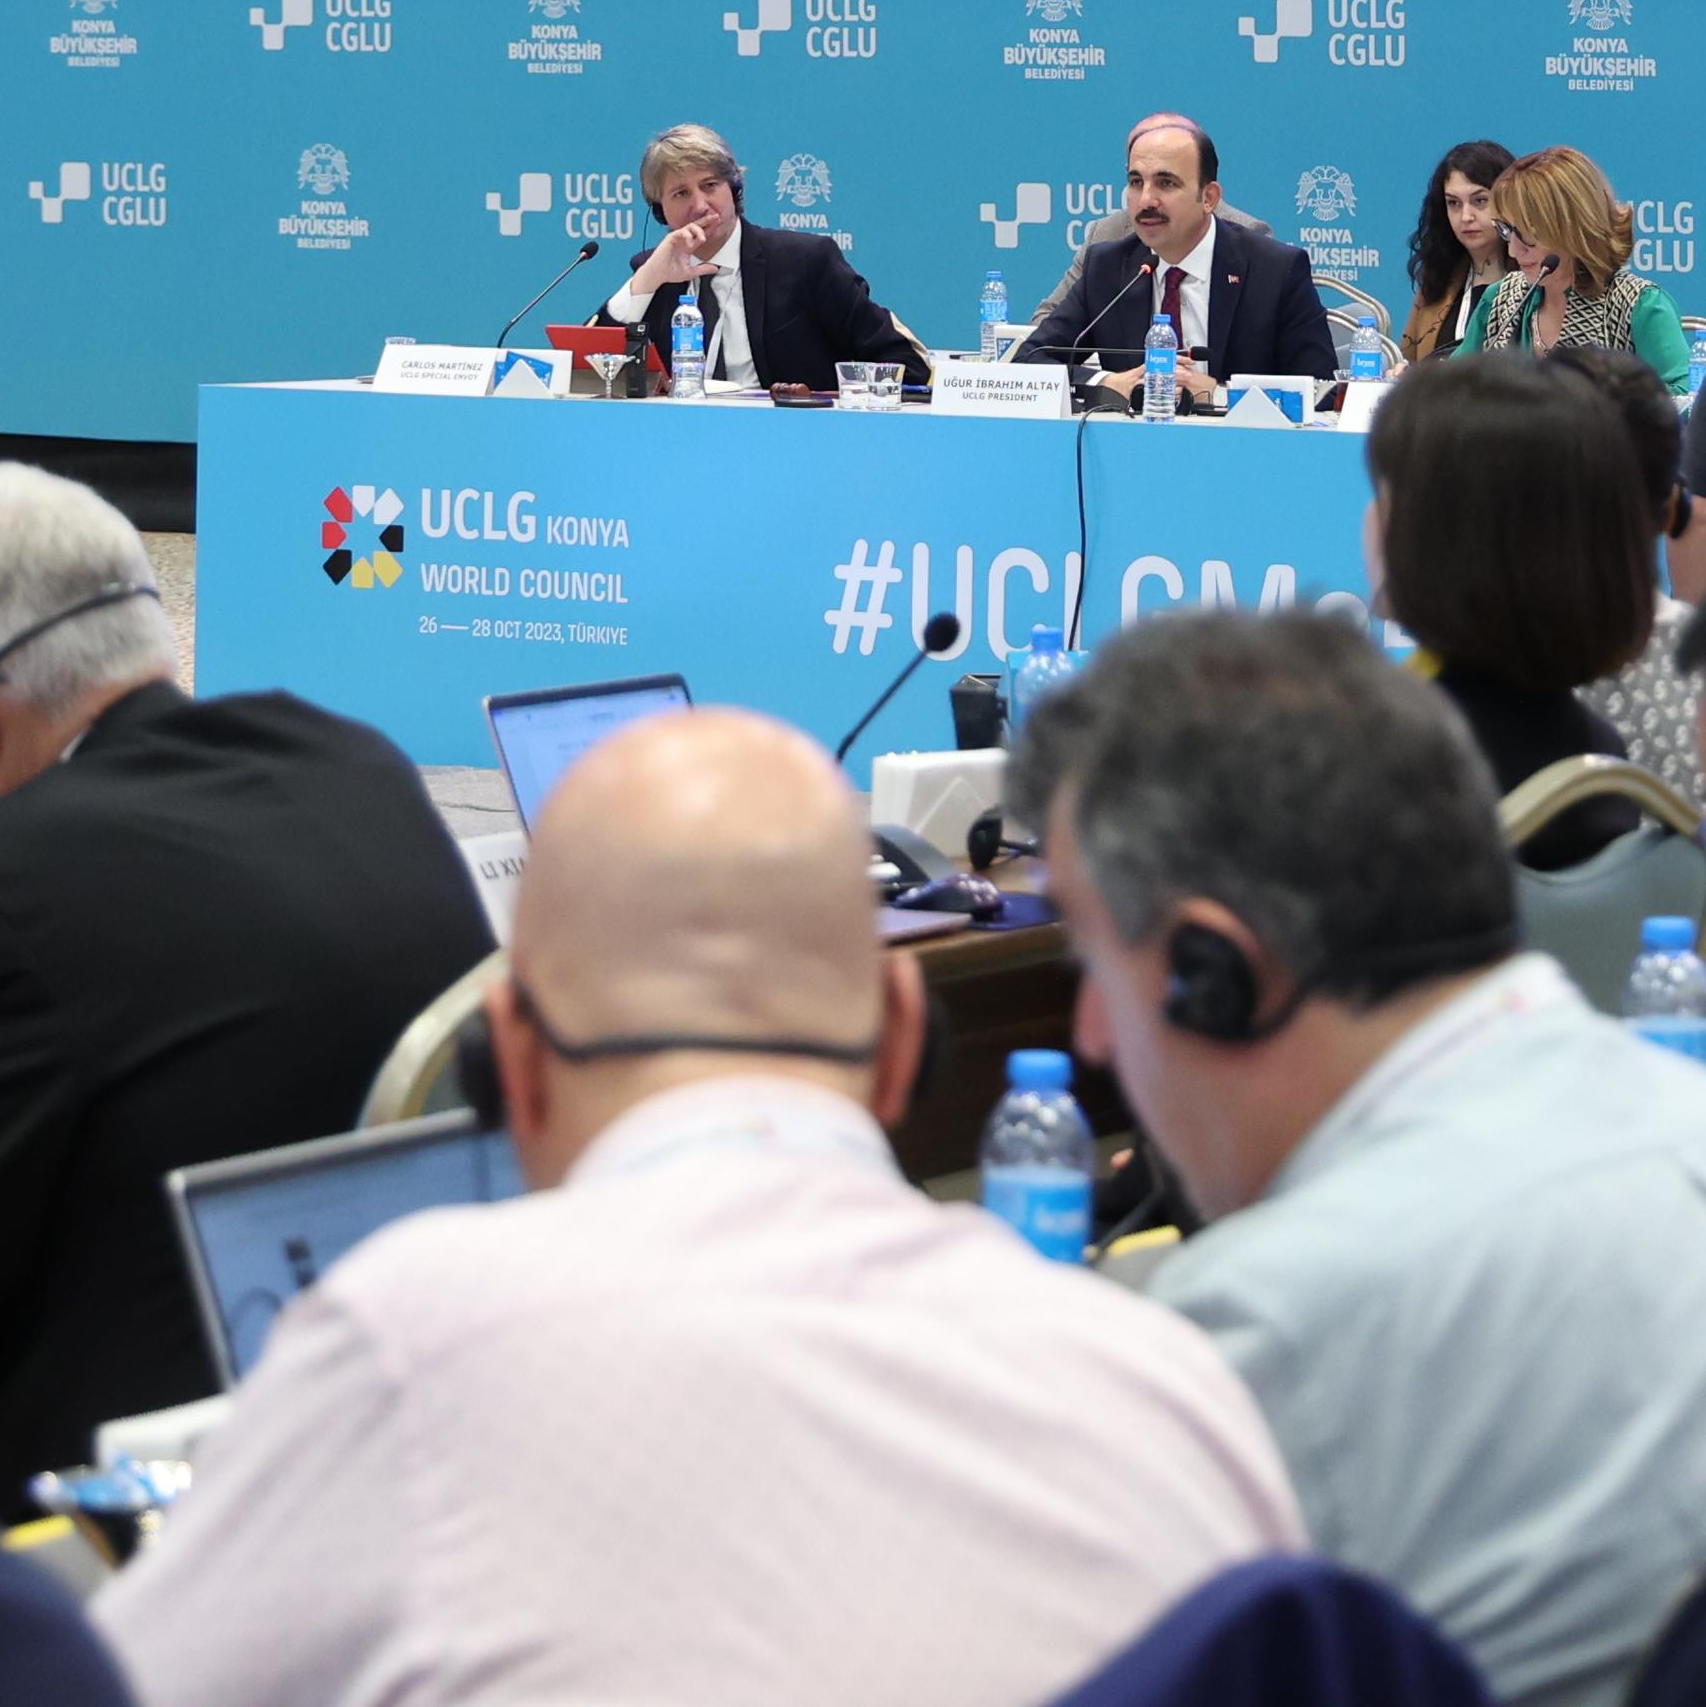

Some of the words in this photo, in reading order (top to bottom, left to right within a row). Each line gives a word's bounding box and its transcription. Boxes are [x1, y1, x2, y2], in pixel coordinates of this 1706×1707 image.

[72, 20, 115, 37] KONYA
[326, 22, 391, 52] CGLU
[532, 25, 578, 42] KONYA
[1029, 29, 1080, 47] KONYA
[508, 37, 601, 62] BÜYÜKŞEHİR
[806, 27, 876, 57] CGLU
[1004, 41, 1105, 69] BÜYÜKŞEHİR
[1329, 33, 1405, 66] CGLU
[1573, 38, 1628, 53] KONYA
[1025, 64, 1085, 79] BELEDİYESİ
[1546, 53, 1656, 78] BÜYÜKŞEHİR
[1569, 78, 1633, 91] BELEDİYESİ
[103, 163, 166, 192] UCLG
[565, 173, 633, 204] UCLG
[103, 196, 166, 226] CGLU
[301, 201, 346, 218] KONYA
[780, 213, 828, 231] KONYA
[1629, 199, 1694, 235] CLG
[279, 213, 369, 240] BÜYÜKŞEHİR
[566, 208, 633, 239] CGLU
[1300, 228, 1352, 246] KONYA
[1627, 238, 1694, 273] GLU
[401, 360, 436, 370] CARLOS
[943, 376, 973, 388] UĞUR
[1026, 381, 1061, 392] ALTAY
[962, 392, 985, 401] UCLG
[988, 393, 1038, 402] PRESIDENT
[421, 488, 536, 543] UCLG
[547, 516, 629, 548] KONYA
[421, 564, 510, 596] WORLD
[520, 569, 628, 603] COUNCIL
[420, 616, 437, 633] 26
[472, 619, 491, 637] 28
[494, 621, 522, 638] OCT
[525, 622, 564, 643] 2023,
